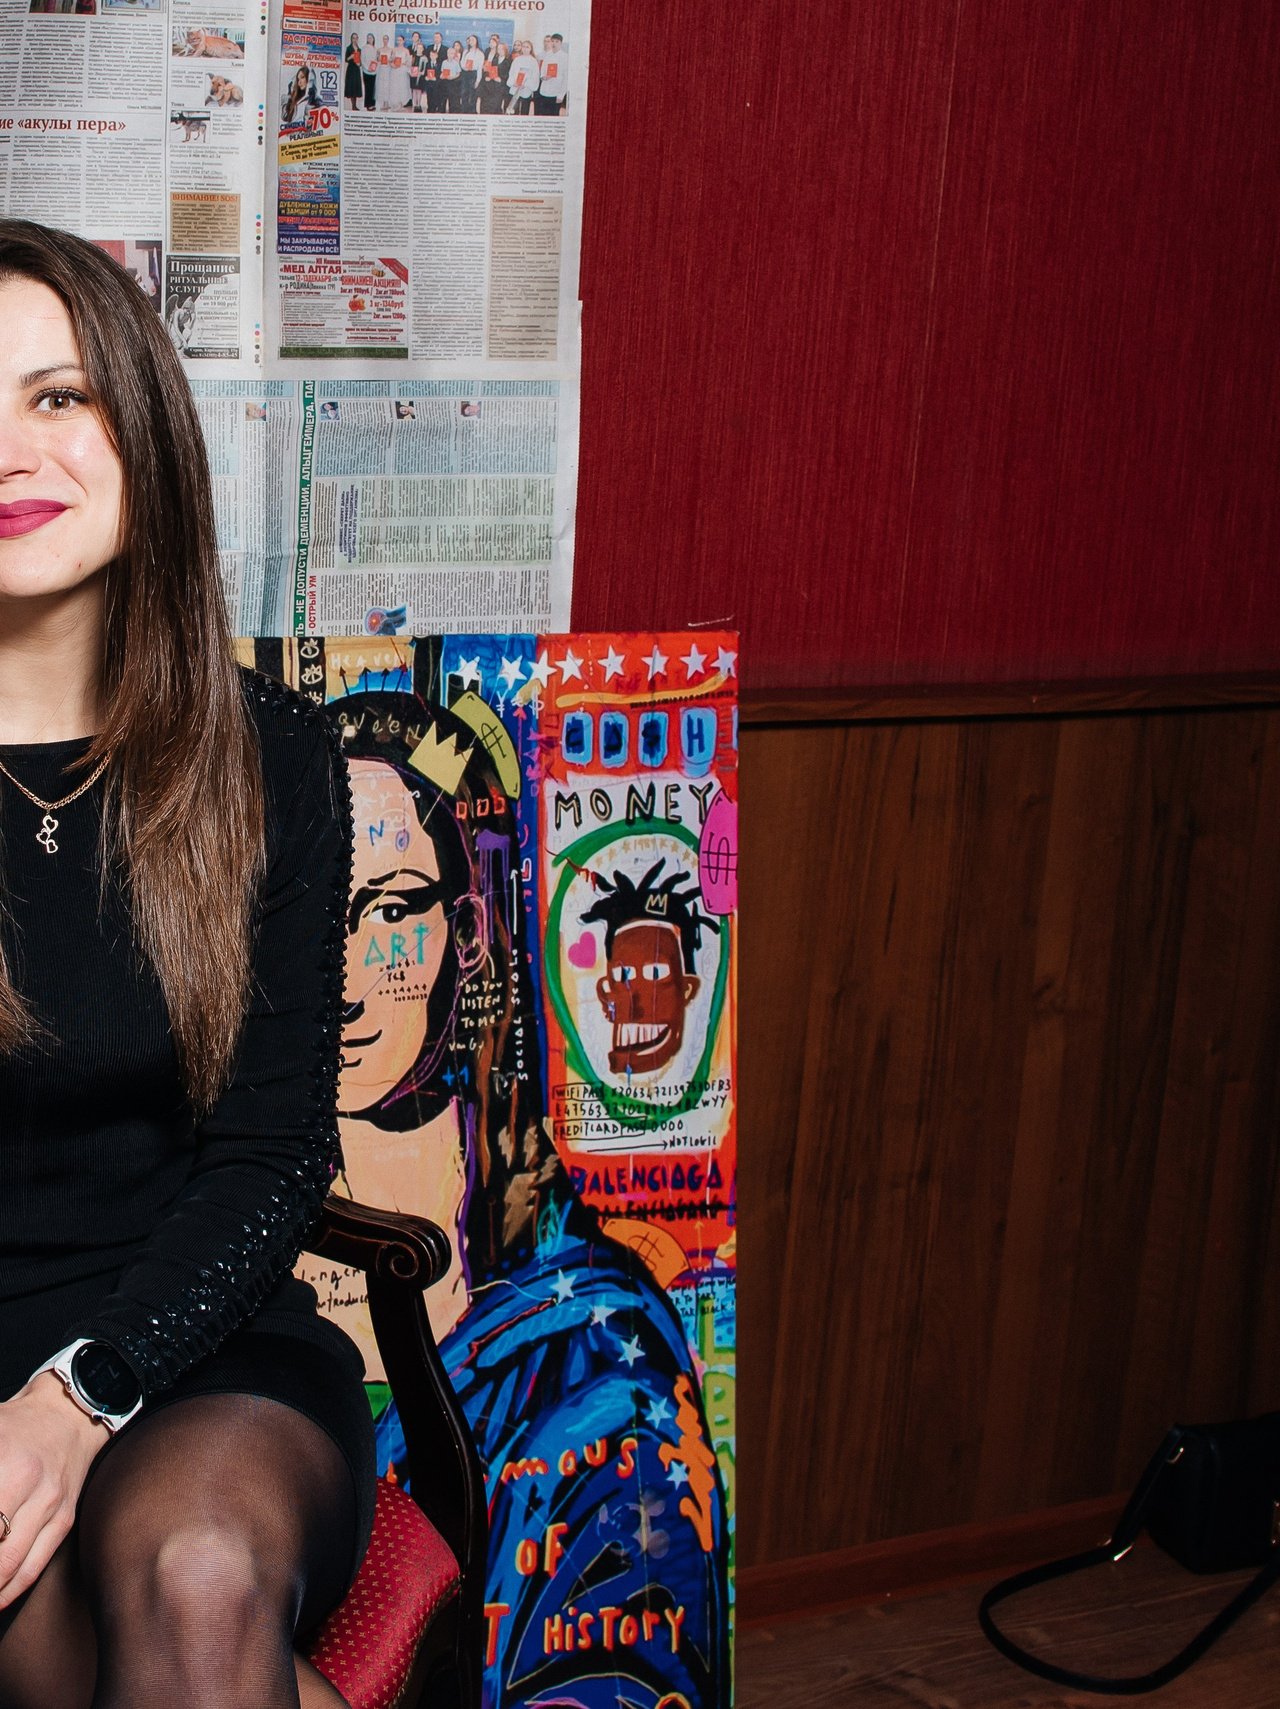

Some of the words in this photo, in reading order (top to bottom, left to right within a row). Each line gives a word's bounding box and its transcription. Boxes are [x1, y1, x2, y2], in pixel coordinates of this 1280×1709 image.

[348, 11, 365, 21] не
[369, 8, 439, 25] бойтесь!
[283, 33, 342, 46] РАСПРОДАЖА
[17, 118, 72, 132] «акулы
[76, 119, 126, 134] пера»
[170, 260, 235, 275] Прощание
[301, 400, 315, 481] АЛЬЦГЕЙМЕРА,
[298, 483, 312, 546] ДЕМЕНЦИИ,
[295, 548, 308, 597] ДОПУСТИ
[309, 575, 318, 591] УМ
[308, 593, 318, 629] ОСТРЫЙ
[554, 780, 714, 831] MONEY
[515, 1522, 569, 1579] OF
